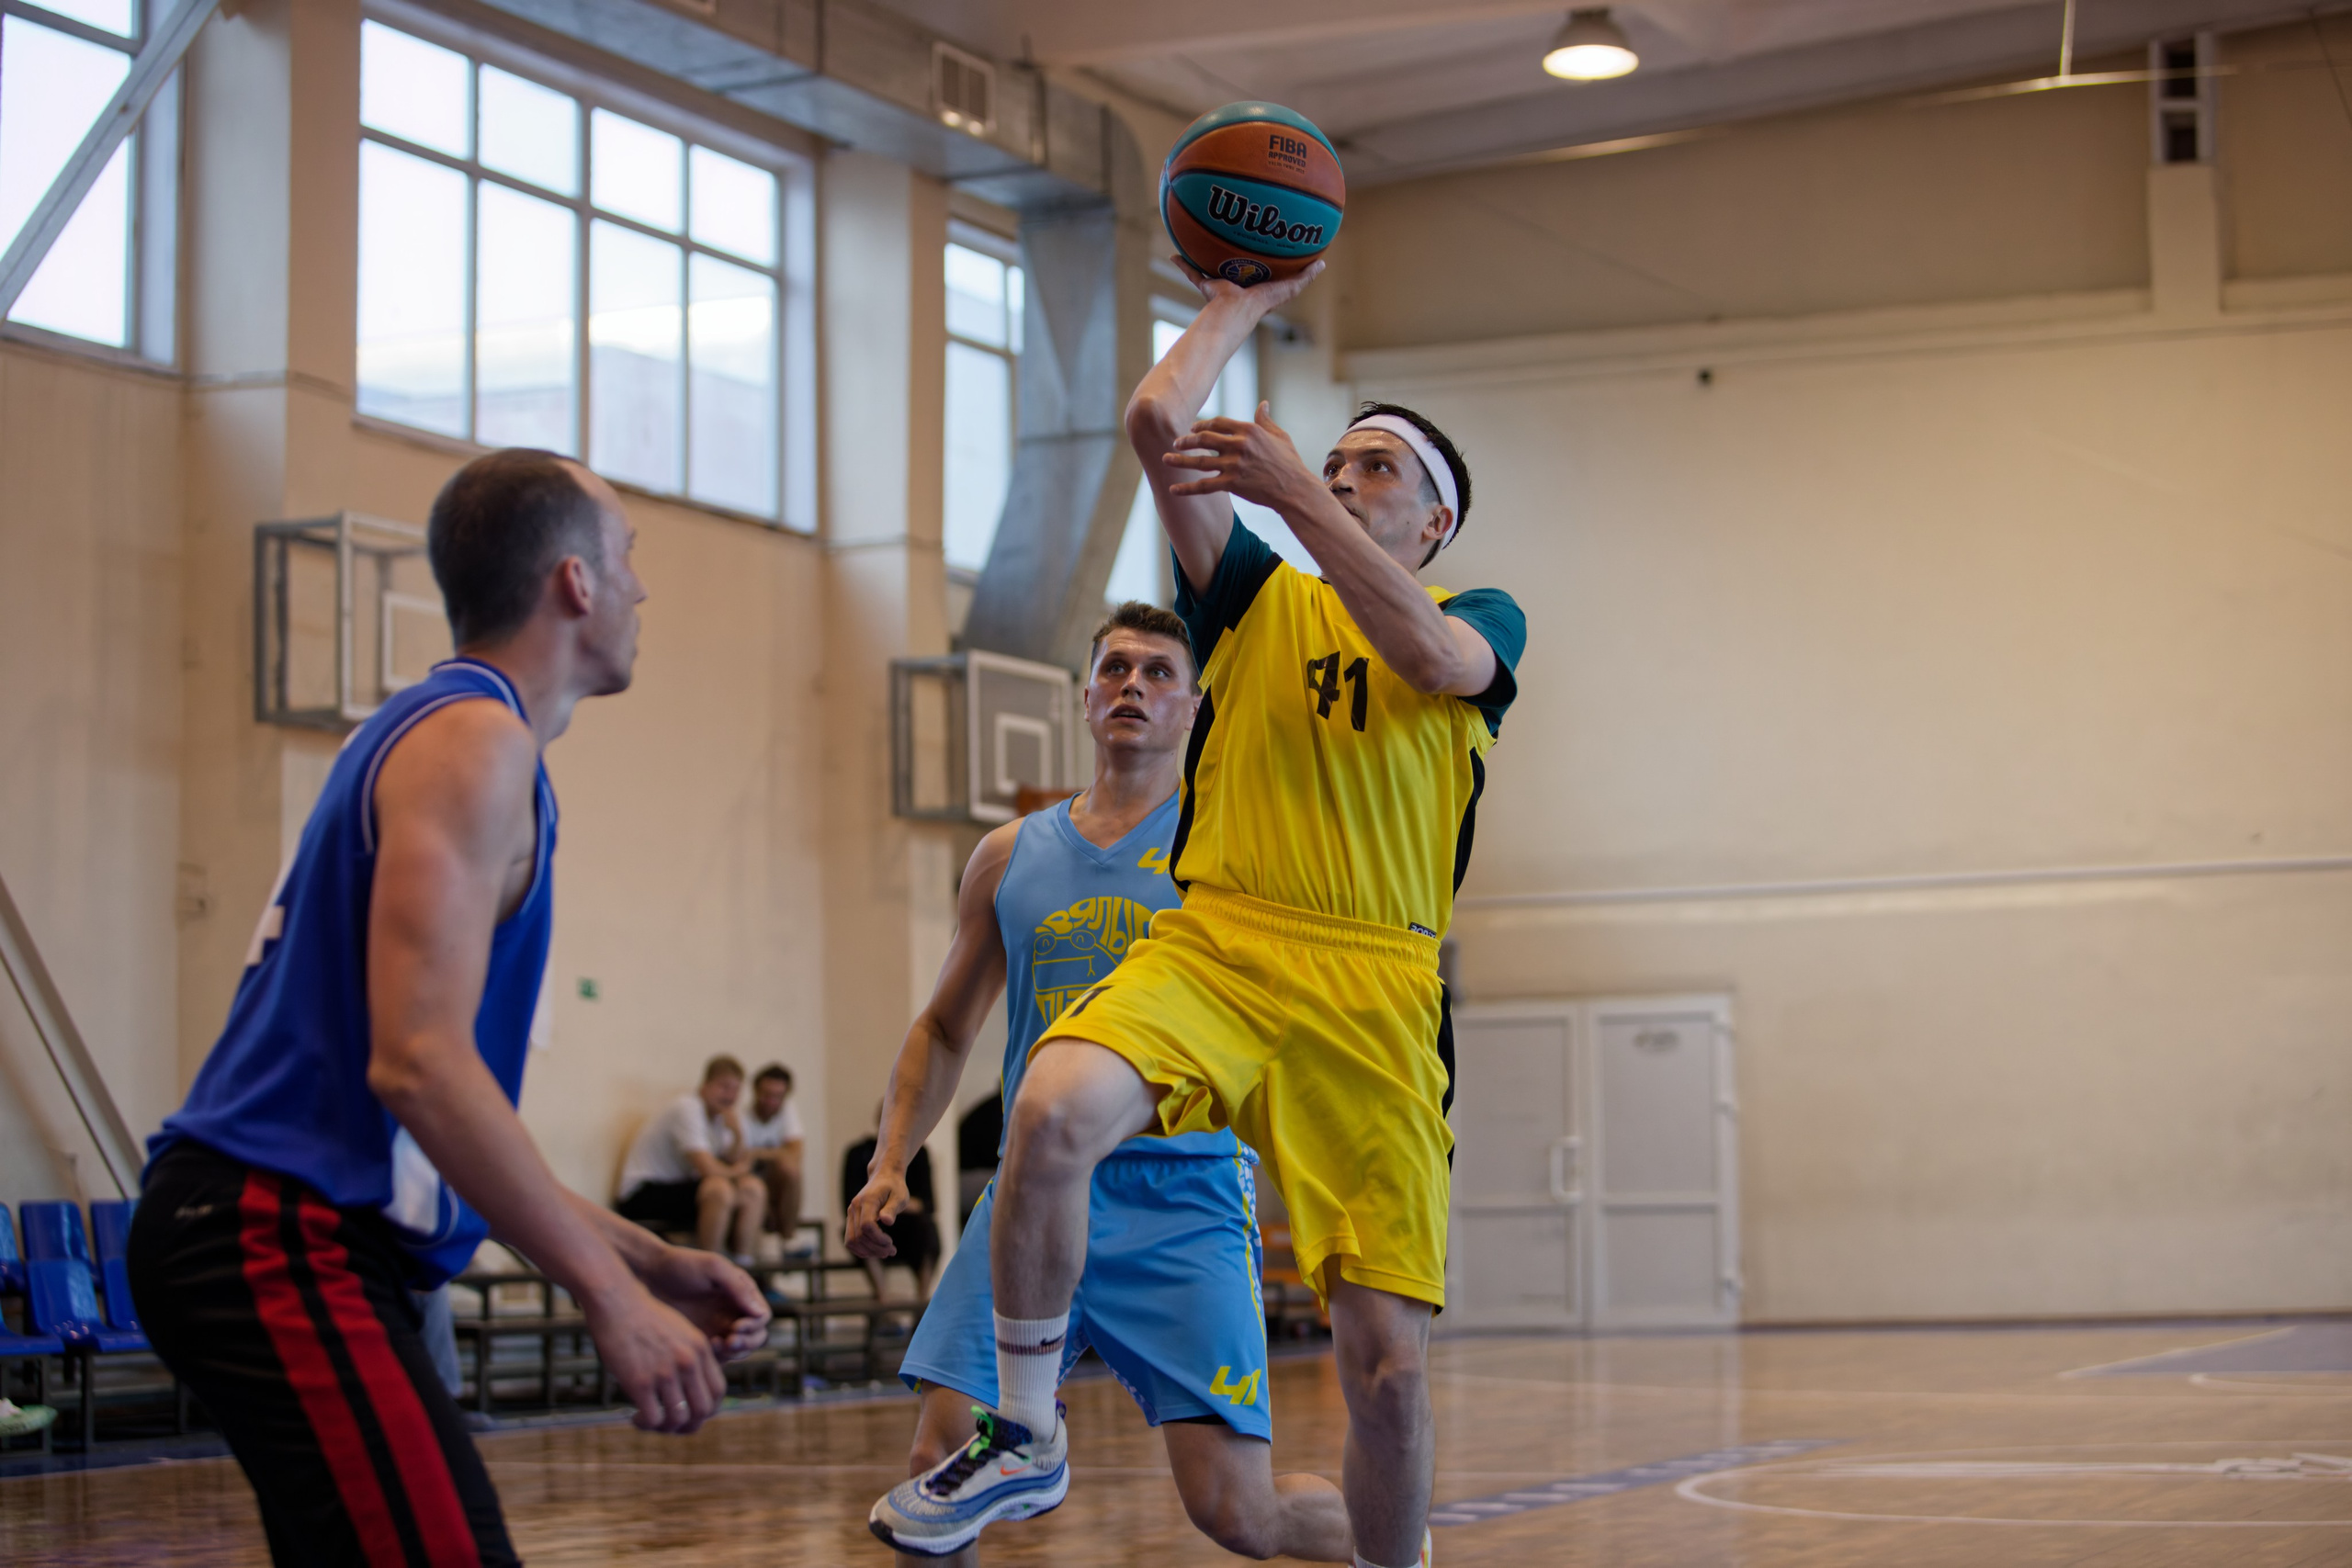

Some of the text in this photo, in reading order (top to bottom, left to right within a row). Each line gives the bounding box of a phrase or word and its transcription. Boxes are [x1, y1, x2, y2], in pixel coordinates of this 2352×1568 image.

[1268, 151, 1306, 168] APPROVED
[1269, 134, 1307, 159] FIBA
[1206, 184, 1324, 245] Wilson
[1306, 650, 1370, 732] 41
[1137, 847, 1171, 874] 4
[1209, 1366, 1261, 1405] 41
